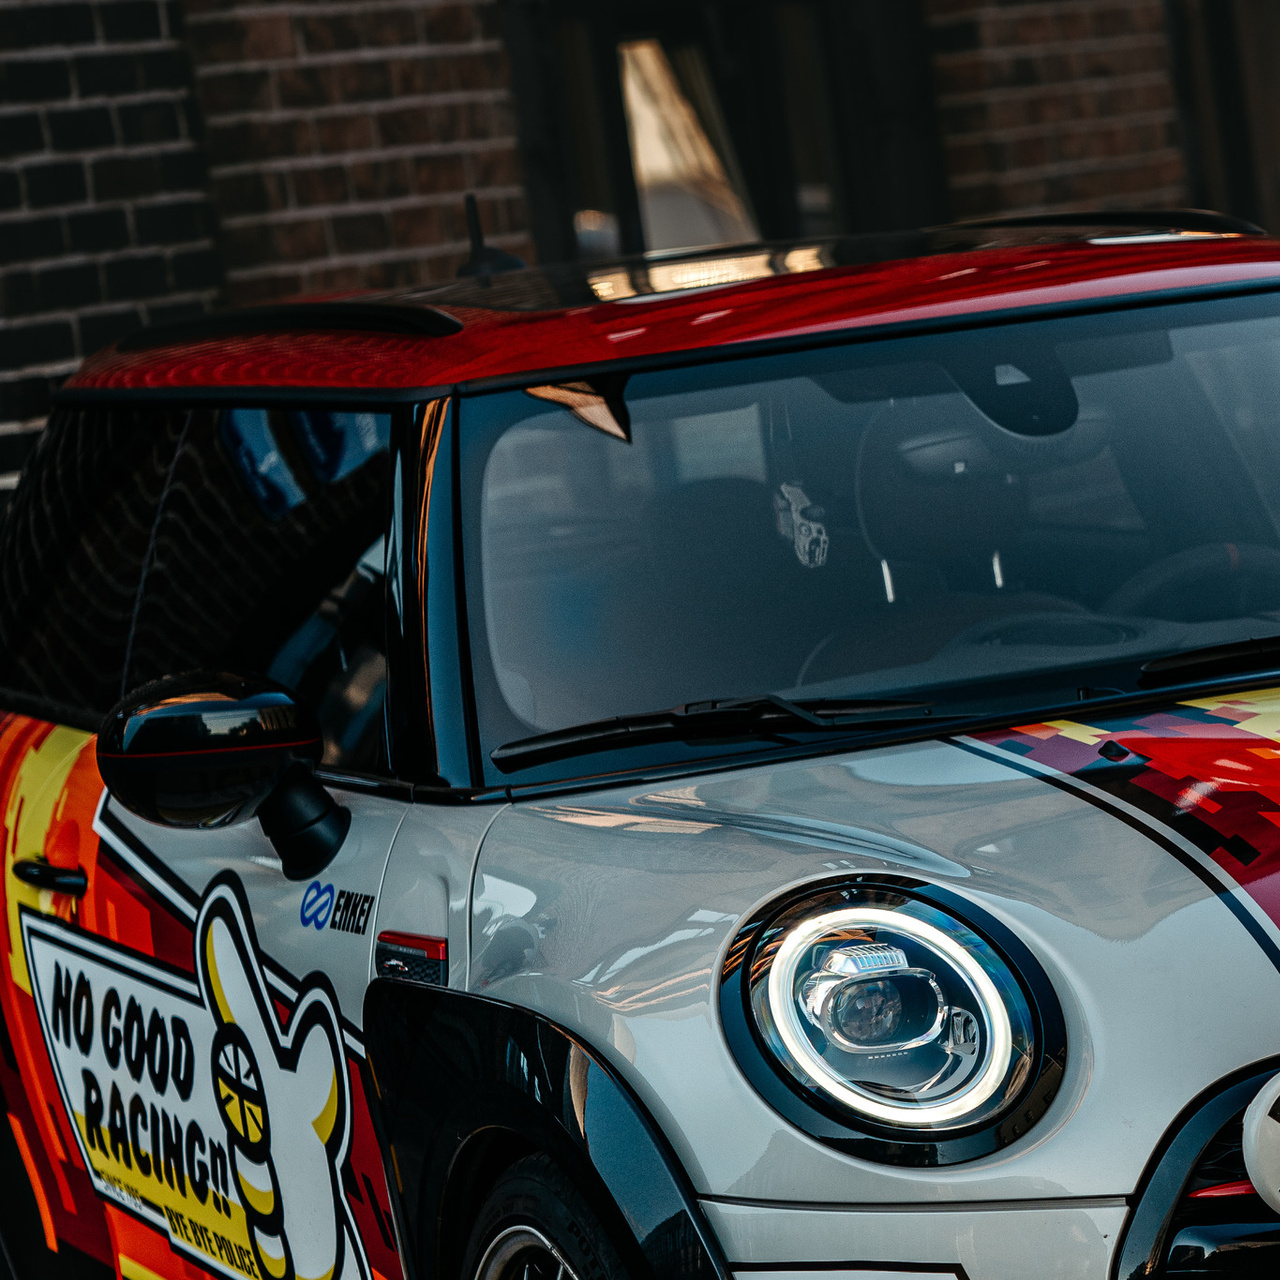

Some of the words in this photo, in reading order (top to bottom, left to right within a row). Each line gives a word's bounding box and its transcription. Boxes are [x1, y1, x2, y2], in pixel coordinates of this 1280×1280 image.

[330, 889, 375, 935] ENKEI
[52, 959, 94, 1058] NO
[101, 986, 195, 1102] GOOD
[81, 1066, 231, 1220] RACING!!
[164, 1205, 192, 1243] BYE
[188, 1218, 217, 1257] BYE
[212, 1231, 260, 1280] POLICE
